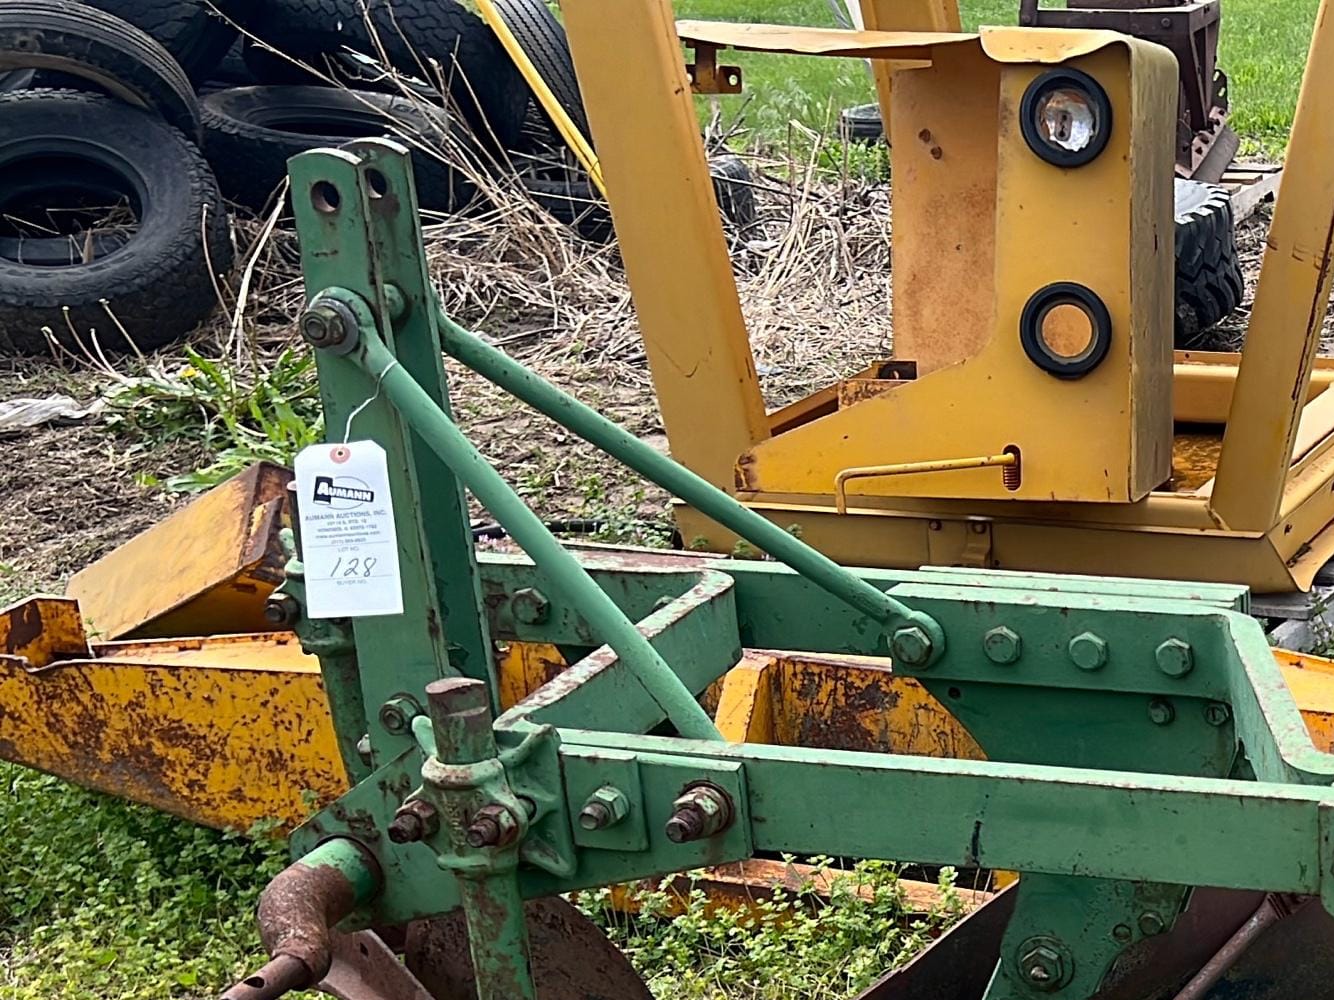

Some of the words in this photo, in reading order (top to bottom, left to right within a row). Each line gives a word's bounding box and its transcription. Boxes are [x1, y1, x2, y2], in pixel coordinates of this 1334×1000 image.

[317, 481, 372, 501] AUMANN
[305, 513, 335, 521] AUMANN
[330, 557, 377, 577] 128
